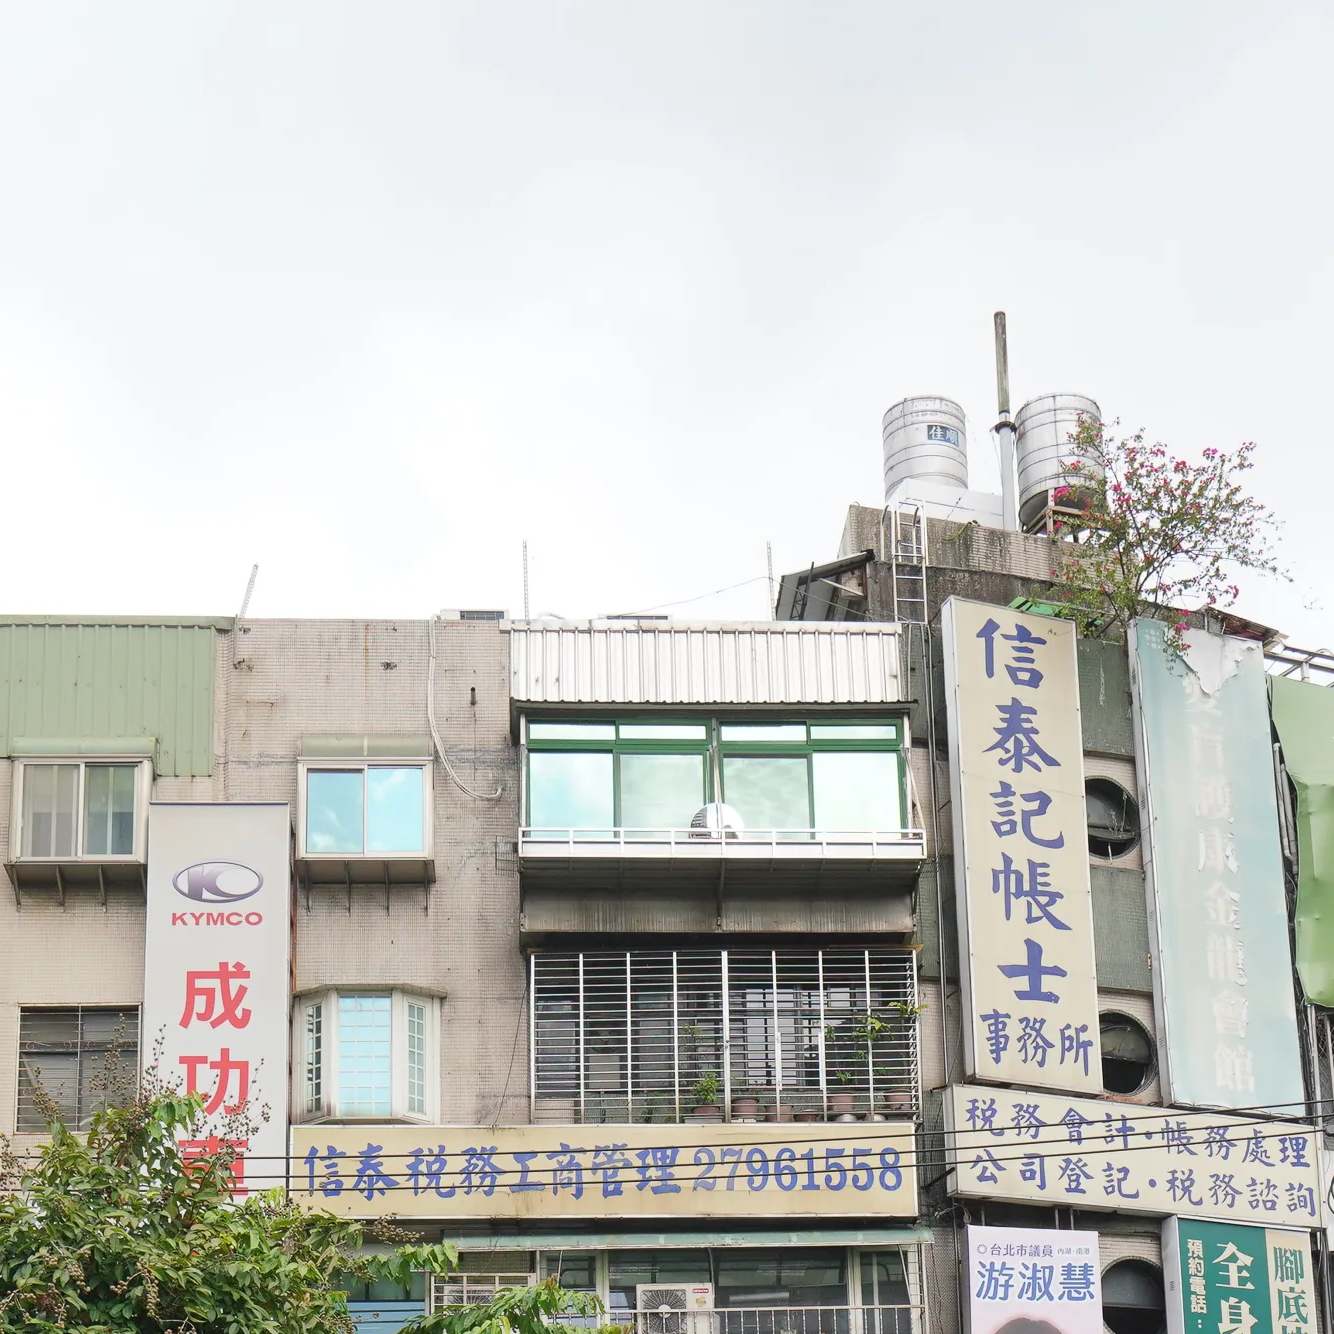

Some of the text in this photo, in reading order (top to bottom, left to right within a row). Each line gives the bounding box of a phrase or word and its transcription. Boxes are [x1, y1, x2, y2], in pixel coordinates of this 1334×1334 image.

[171, 912, 263, 926] KYMCO
[979, 1008, 1094, 1077] 事務所
[692, 1146, 903, 1192] 27961558
[990, 1244, 1053, 1257] 台北市議員
[976, 1261, 1095, 1301] 游淑慧
